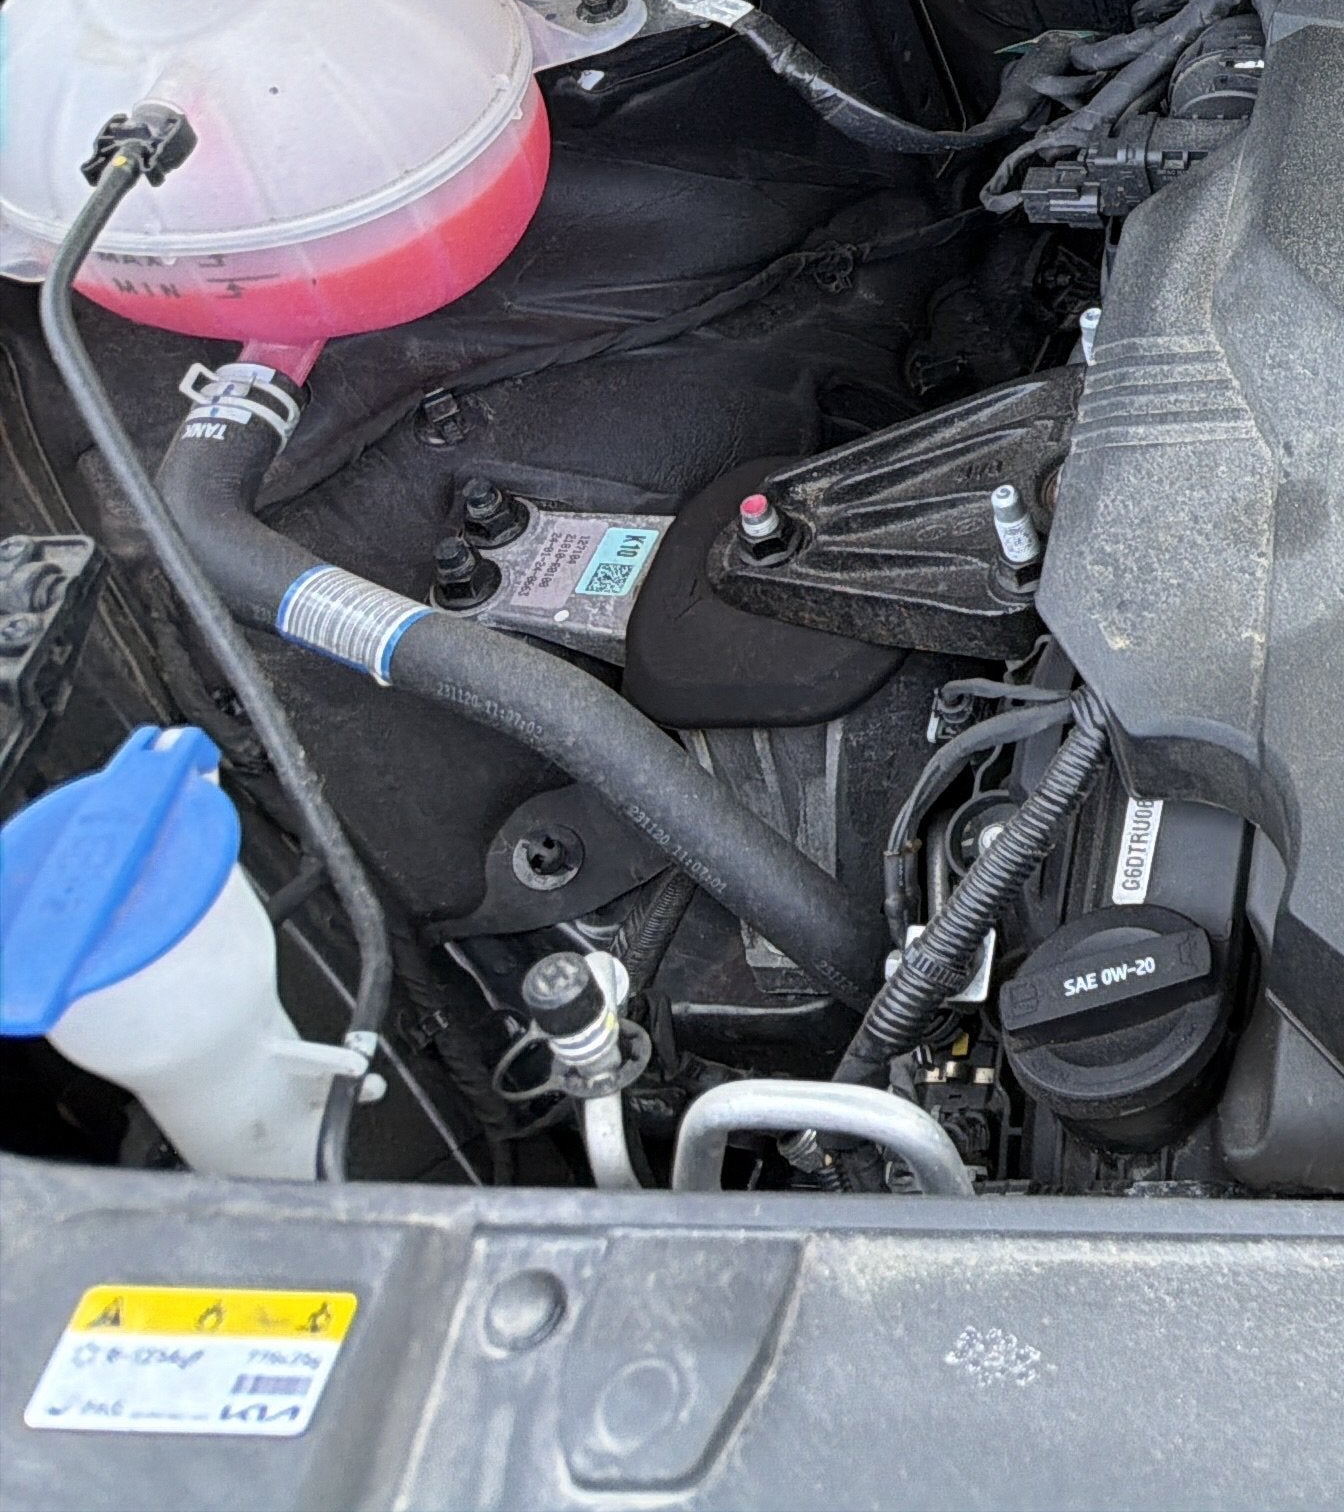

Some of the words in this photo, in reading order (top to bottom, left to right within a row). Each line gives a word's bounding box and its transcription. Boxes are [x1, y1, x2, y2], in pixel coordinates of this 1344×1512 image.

[112, 276, 182, 299] MIN
[182, 422, 228, 441] TANK
[616, 534, 647, 558] K10
[1063, 972, 1099, 997] SAE
[1100, 956, 1156, 986] 0W-20
